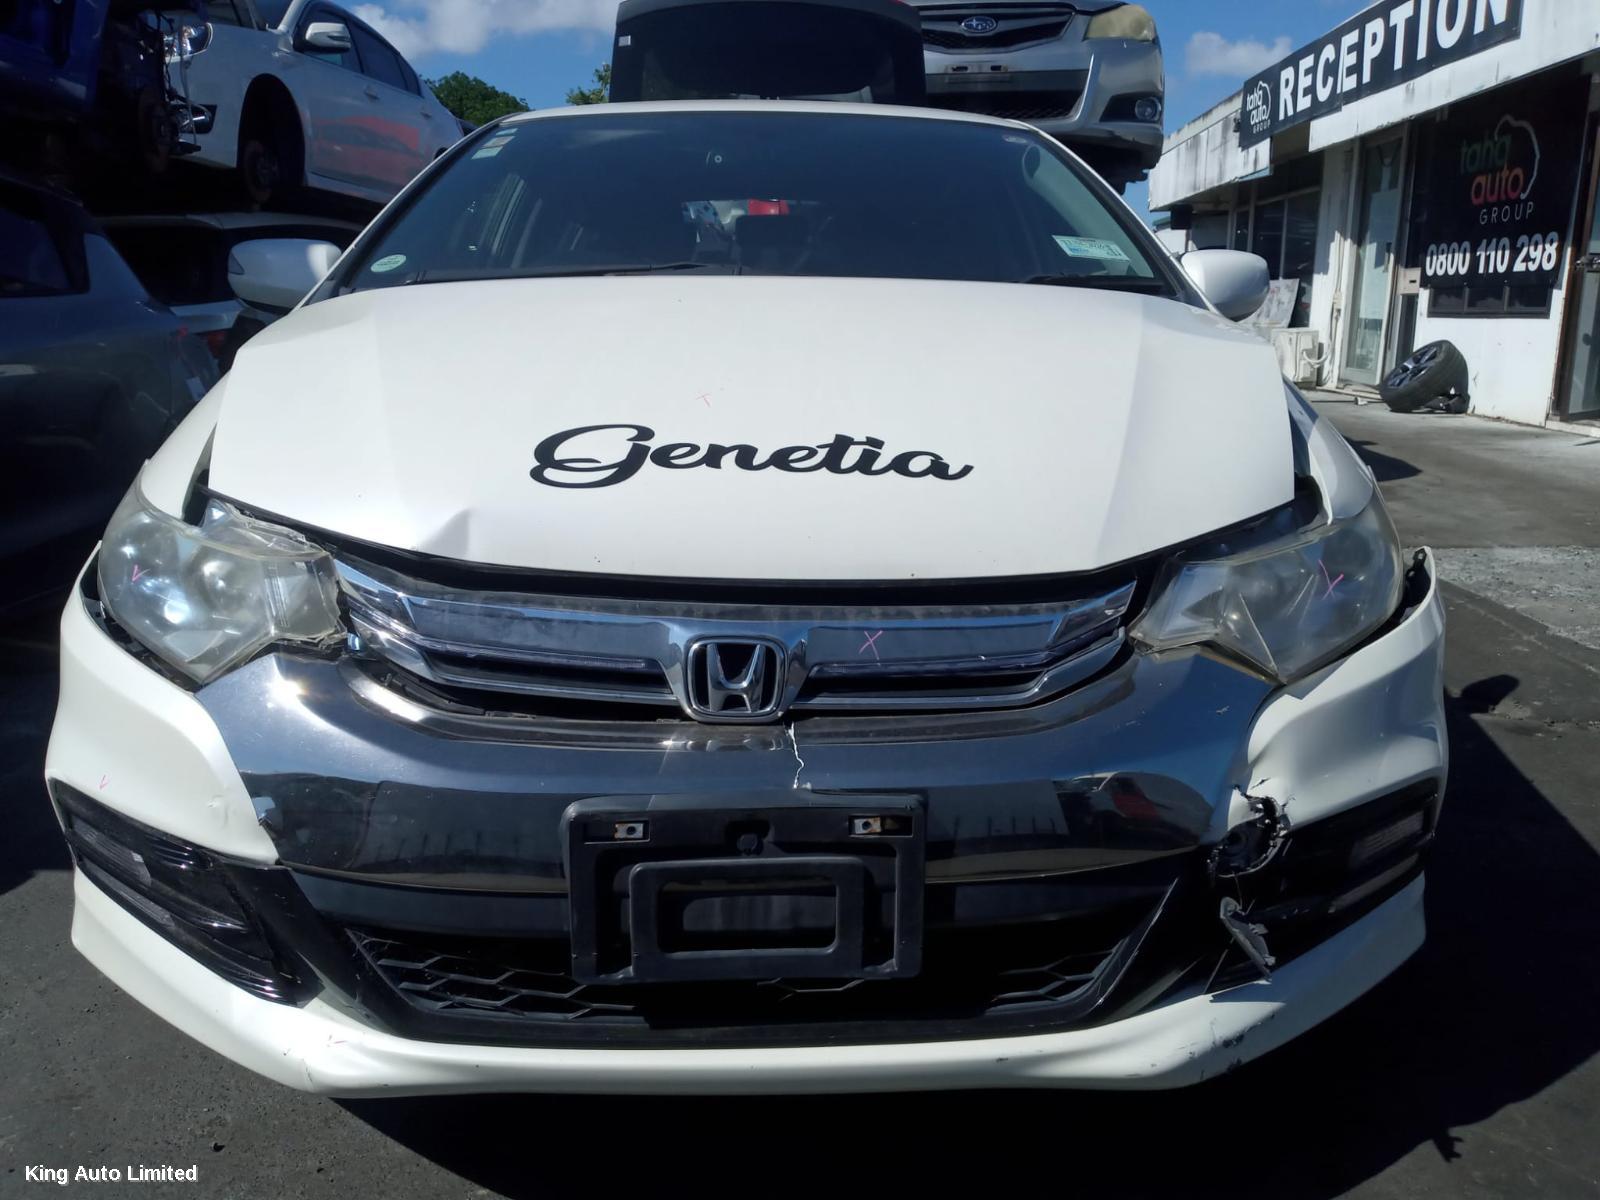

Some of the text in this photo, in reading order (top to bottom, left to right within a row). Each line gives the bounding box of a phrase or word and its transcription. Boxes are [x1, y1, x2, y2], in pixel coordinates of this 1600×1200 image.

[1250, 104, 1267, 126] auto
[1471, 161, 1524, 205] auto
[1479, 201, 1534, 225] GROUP
[1425, 231, 1559, 277] 0800 110 298
[529, 423, 975, 489] Genetia
